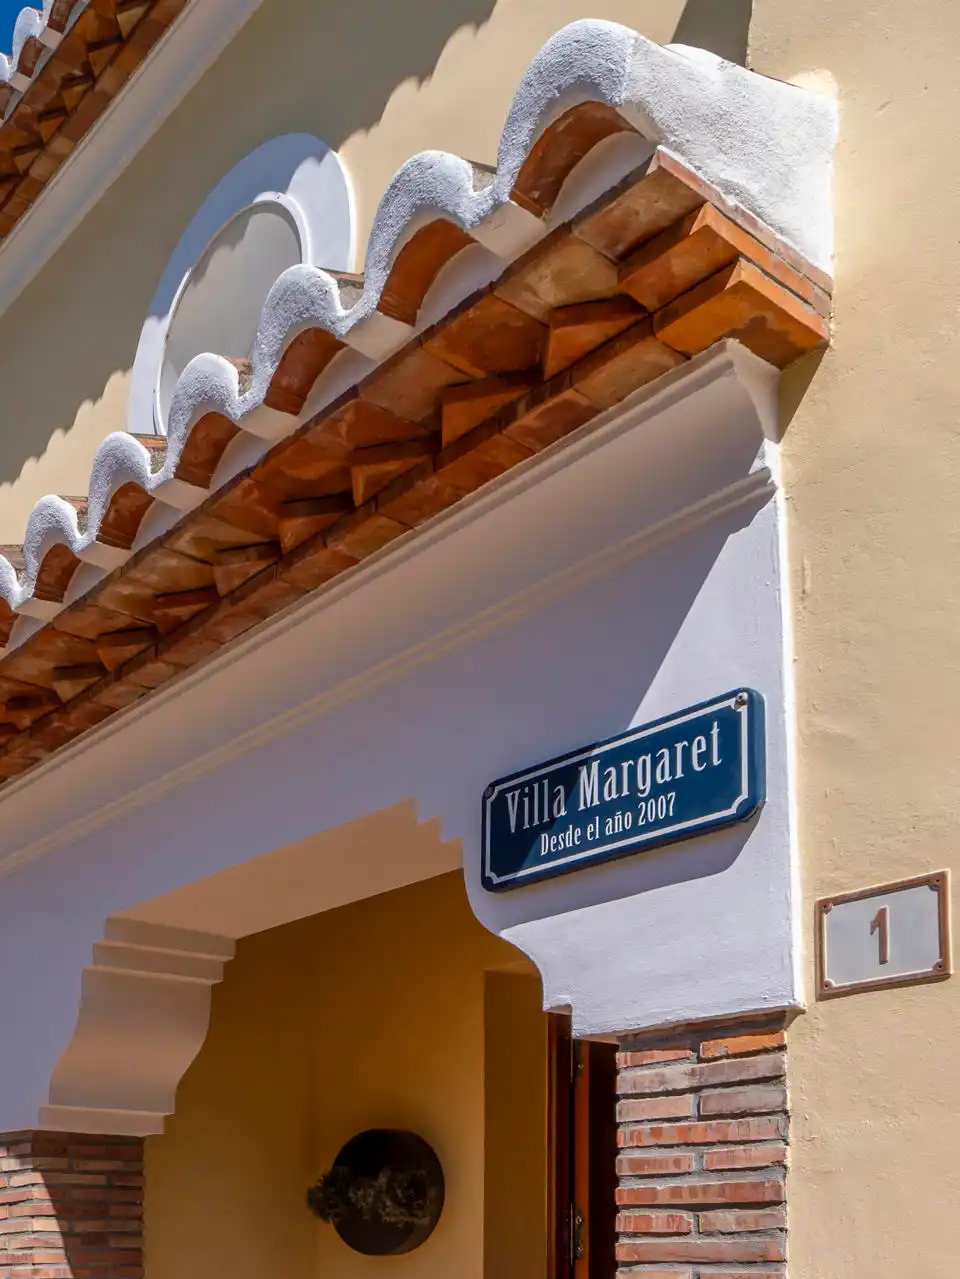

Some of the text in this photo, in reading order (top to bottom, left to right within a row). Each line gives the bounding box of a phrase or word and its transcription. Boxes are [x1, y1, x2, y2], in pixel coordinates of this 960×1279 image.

[505, 720, 722, 834] Villa Margaret
[540, 791, 677, 856] Desde el año 2007
[870, 905, 890, 965] 1
